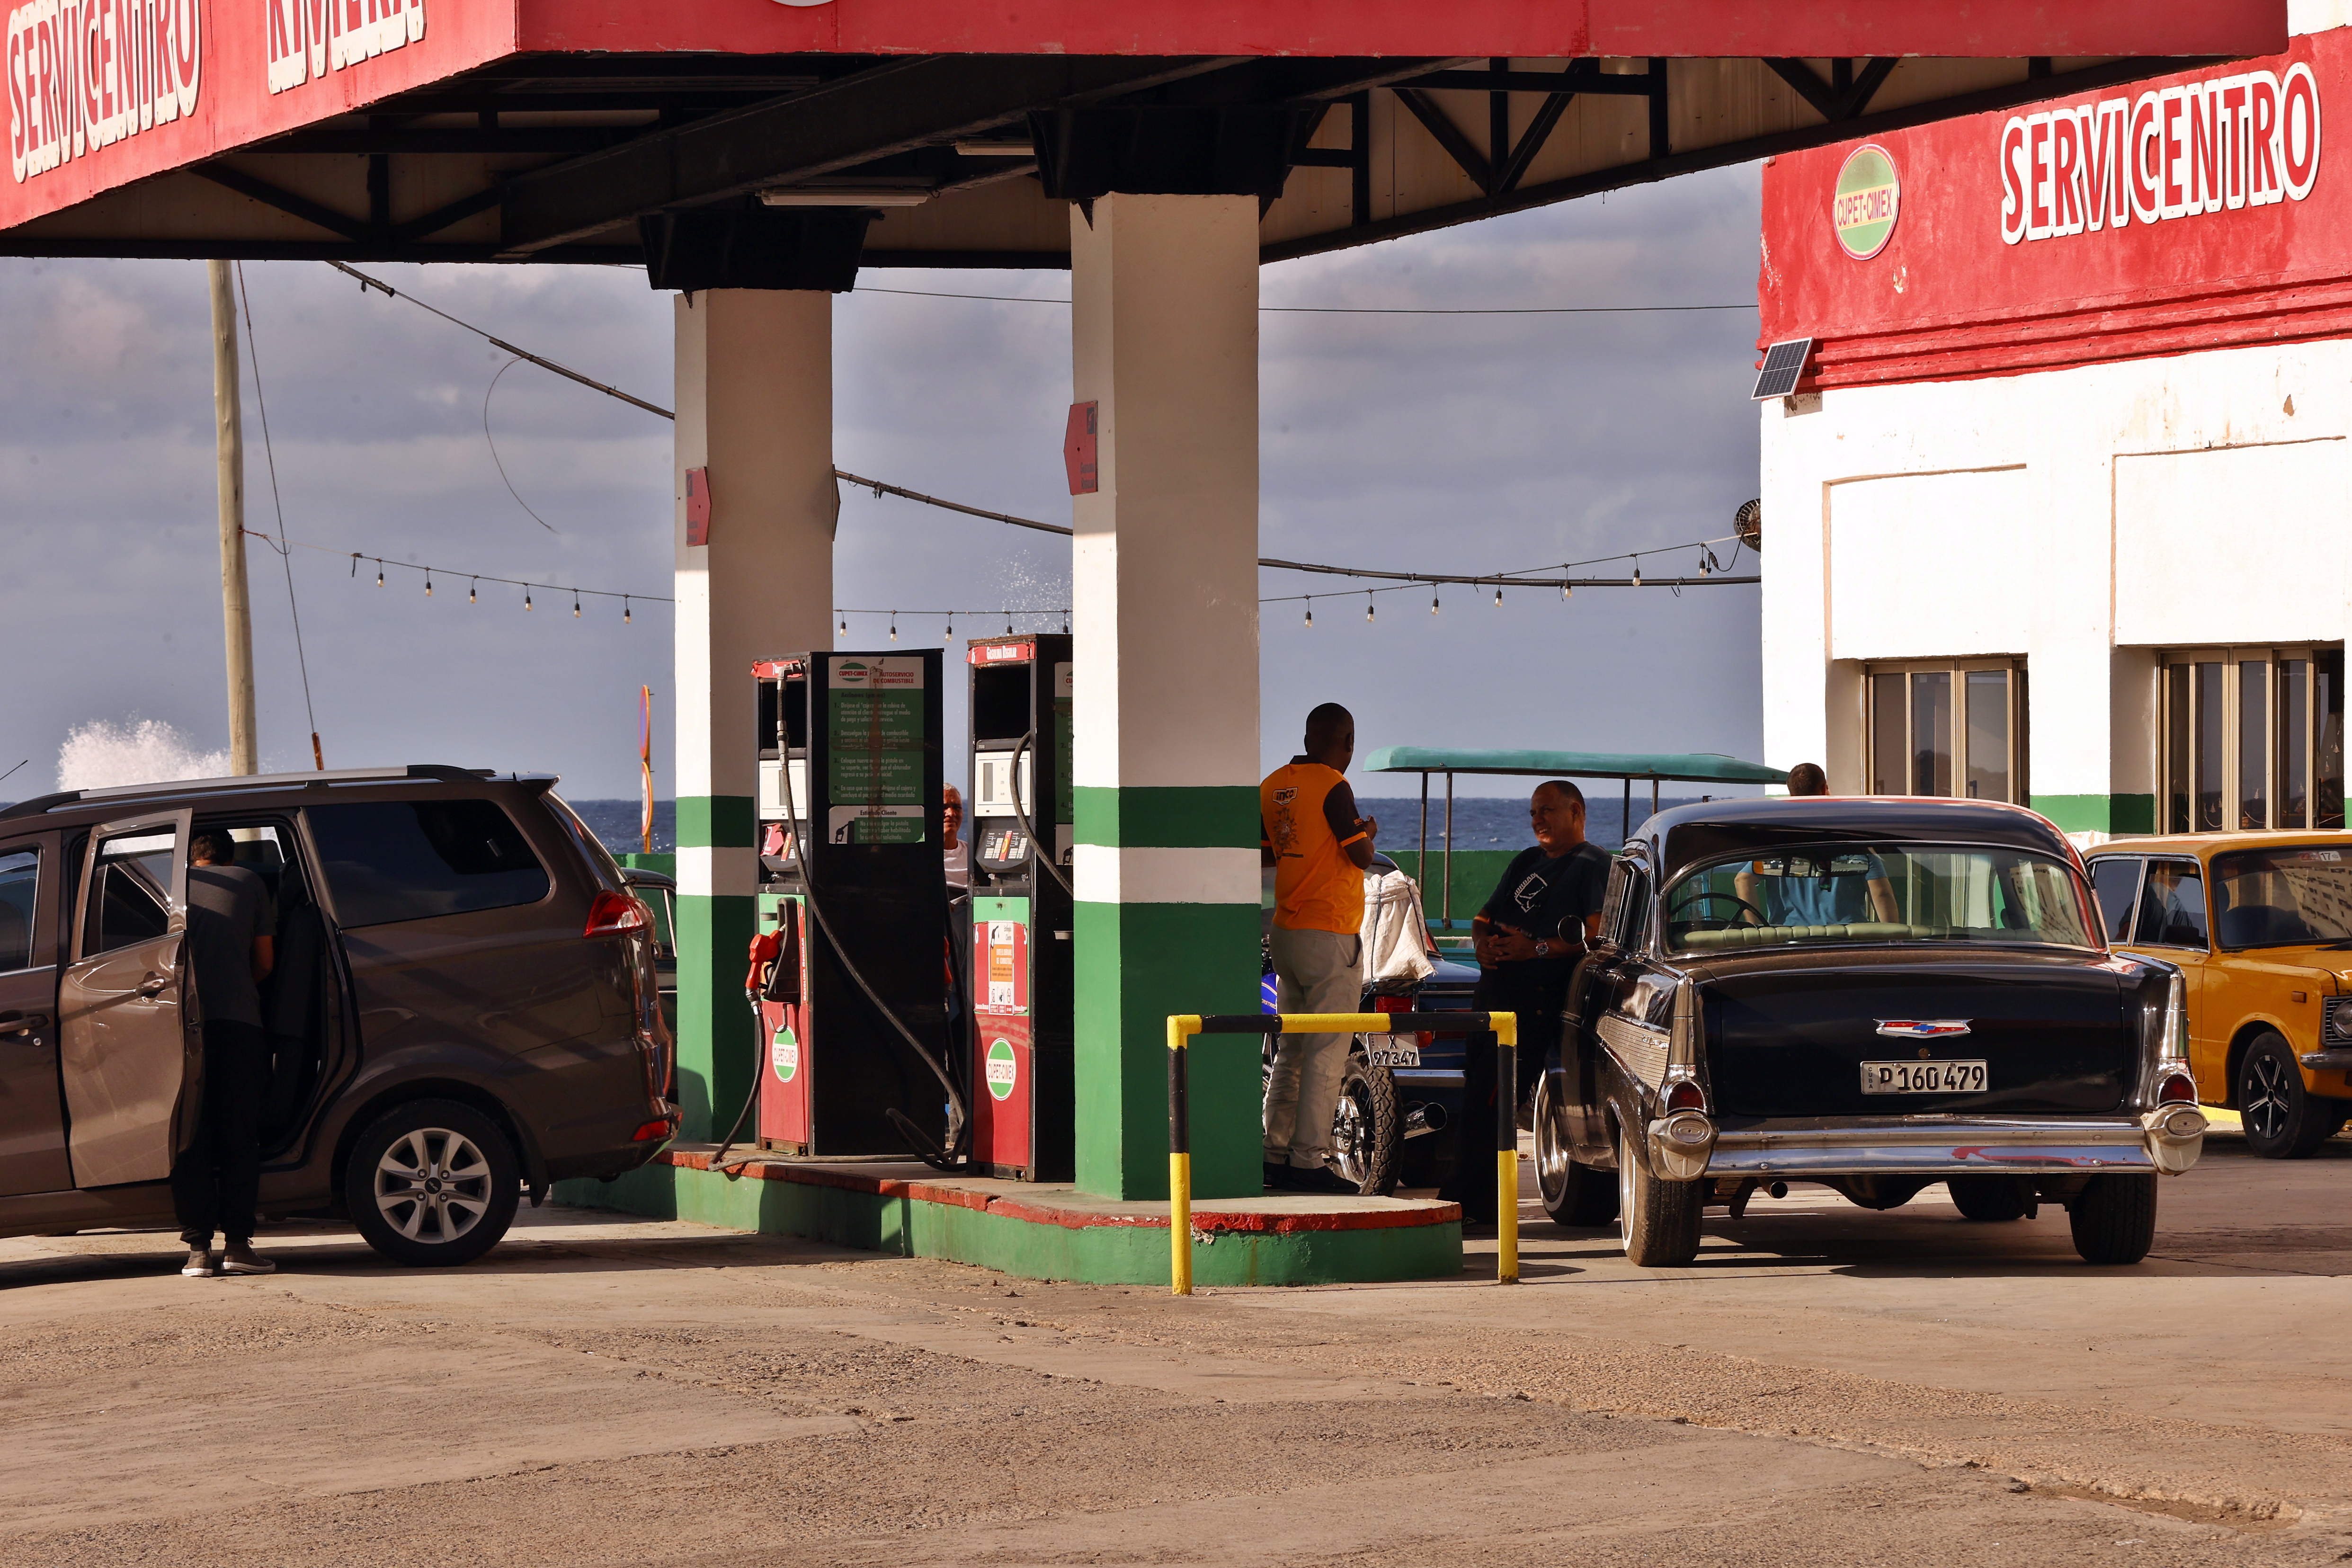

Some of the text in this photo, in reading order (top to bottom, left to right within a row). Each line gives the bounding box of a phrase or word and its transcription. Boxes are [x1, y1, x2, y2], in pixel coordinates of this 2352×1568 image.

[7, 0, 201, 184] SERVICENTRO
[2001, 62, 2322, 245] SERVICENTRO
[1837, 187, 1893, 227] CUPET-CIMEX
[2320, 852, 2330, 860] 17
[1387, 1035, 1397, 1049] X
[1372, 1051, 1416, 1065] 97347
